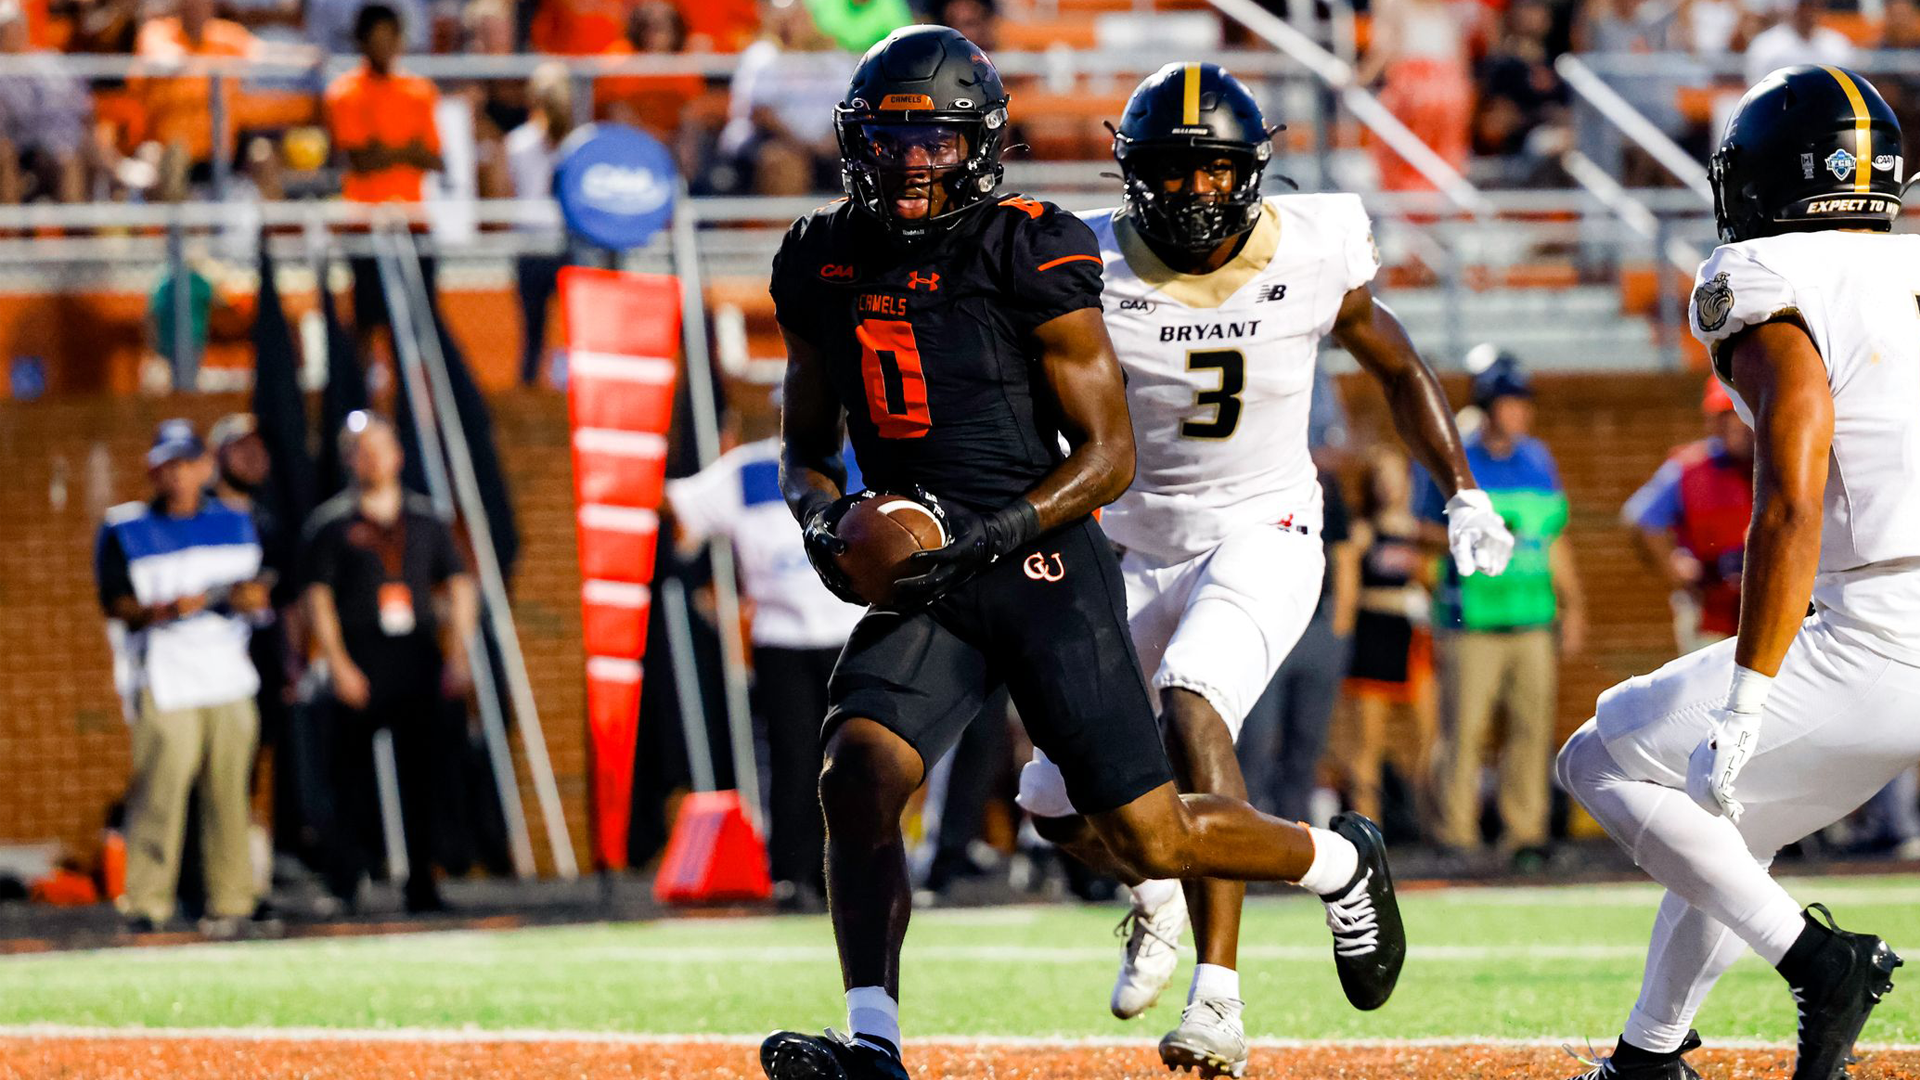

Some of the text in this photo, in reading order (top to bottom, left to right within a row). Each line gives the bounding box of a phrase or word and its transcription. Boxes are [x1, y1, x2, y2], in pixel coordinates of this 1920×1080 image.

[890, 95, 922, 103] CAMELS
[1806, 199, 1868, 214] EXPECT
[1869, 200, 1885, 212] TO
[820, 264, 854, 279] CAA
[858, 294, 907, 316] CAMELS
[1120, 300, 1148, 311] CAA
[1159, 320, 1261, 342] BRYANT
[855, 318, 932, 438] 0
[1180, 348, 1247, 442] 3
